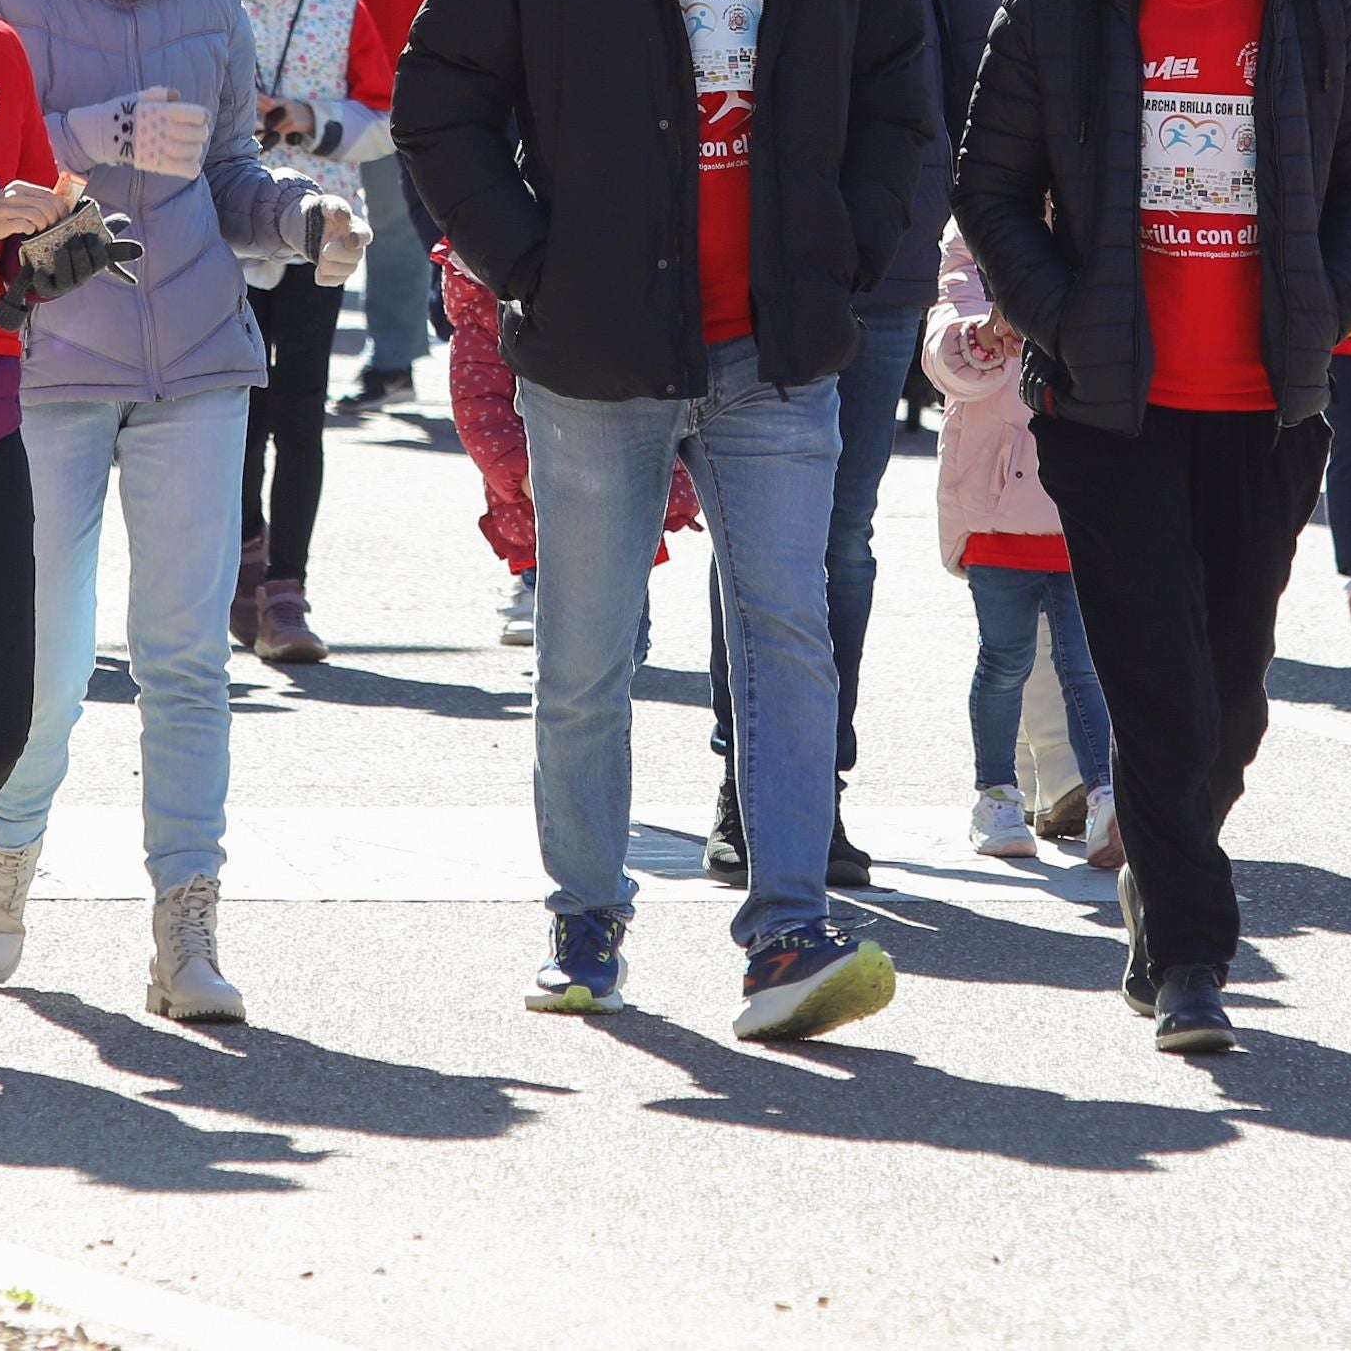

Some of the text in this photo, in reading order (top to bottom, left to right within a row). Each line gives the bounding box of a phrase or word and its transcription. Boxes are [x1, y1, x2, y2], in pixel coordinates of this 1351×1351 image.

[1143, 55, 1200, 80] NAEL
[1179, 100, 1213, 115] BRILLA
[1215, 103, 1234, 116] CON
[1196, 229, 1233, 245] con
[1237, 224, 1258, 245] ell
